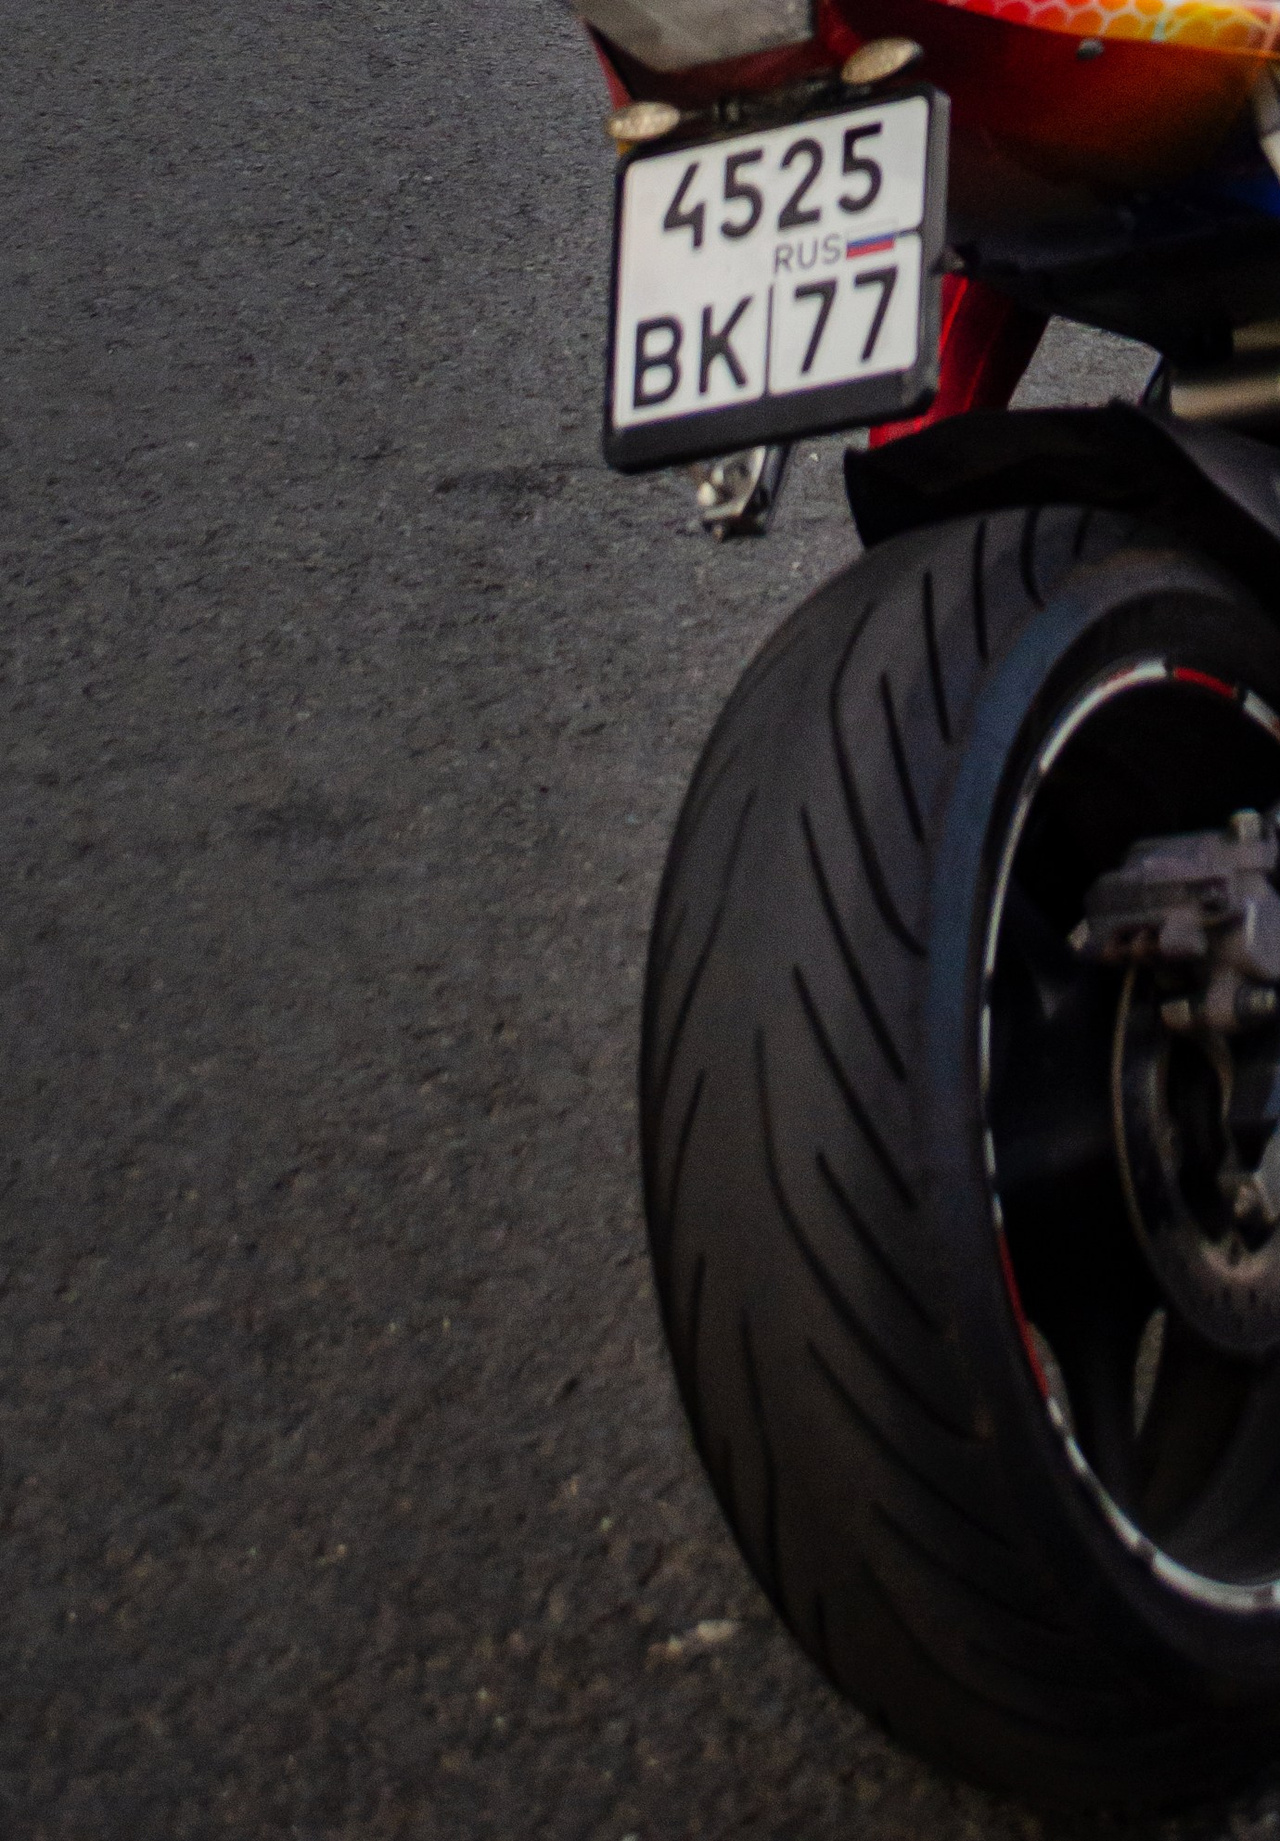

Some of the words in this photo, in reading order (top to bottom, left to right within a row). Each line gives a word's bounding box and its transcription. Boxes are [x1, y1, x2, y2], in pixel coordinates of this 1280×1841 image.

[661, 121, 884, 253] 4525
[772, 234, 842, 274] RUS
[794, 265, 899, 377] 77
